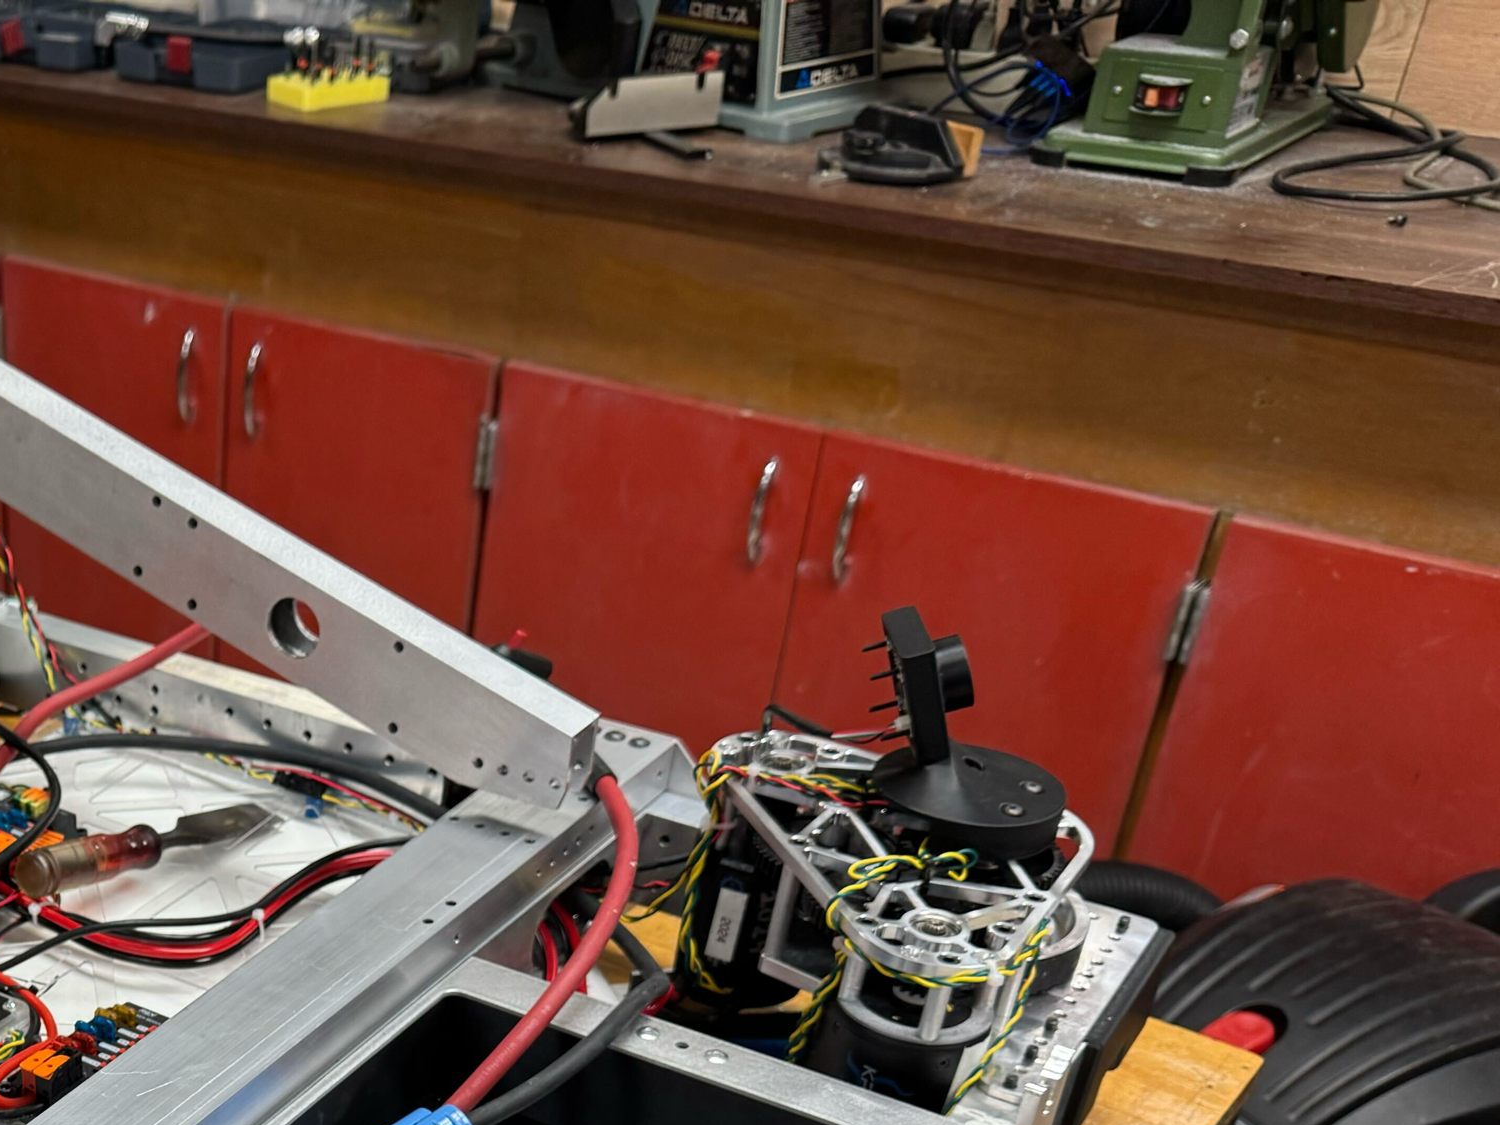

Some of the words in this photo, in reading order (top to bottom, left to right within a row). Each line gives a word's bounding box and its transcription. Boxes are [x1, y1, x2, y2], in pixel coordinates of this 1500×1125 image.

[689, 1, 749, 24] DELTA
[811, 64, 860, 86] DELTA
[717, 916, 731, 943] 2024
